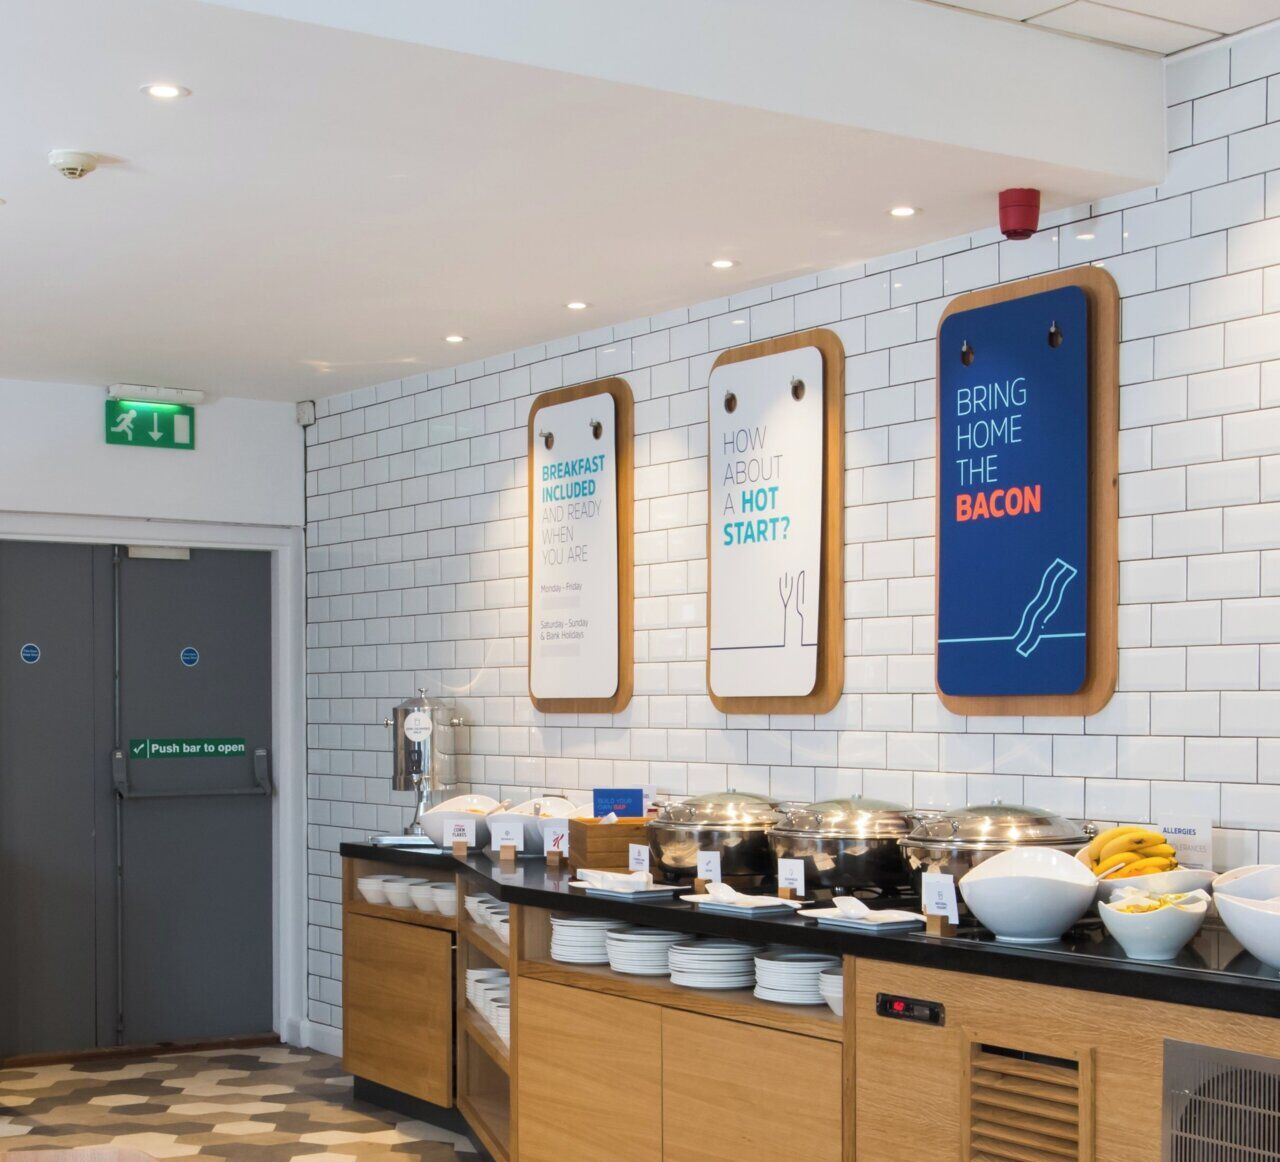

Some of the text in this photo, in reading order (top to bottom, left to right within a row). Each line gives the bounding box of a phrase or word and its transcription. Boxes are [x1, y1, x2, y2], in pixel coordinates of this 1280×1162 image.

[957, 377, 1026, 416] BRING
[723, 425, 767, 455] HOW
[957, 414, 1022, 451] HOME
[542, 454, 605, 482] BREAKFAST
[723, 454, 783, 487] ABOUT
[956, 455, 998, 486] THE
[542, 479, 596, 503] INCLUDED
[723, 486, 779, 516] A HOT
[956, 484, 1041, 522] BACON
[542, 499, 602, 523] AND READY
[542, 526, 574, 545] WHEN
[723, 515, 790, 546] START?
[542, 544, 588, 566] YOU ARE
[540, 584, 561, 593] Monday
[565, 582, 583, 591] Friday
[151, 743, 245, 754] Push bar to open
[1162, 827, 1196, 835] ALLERGIES
